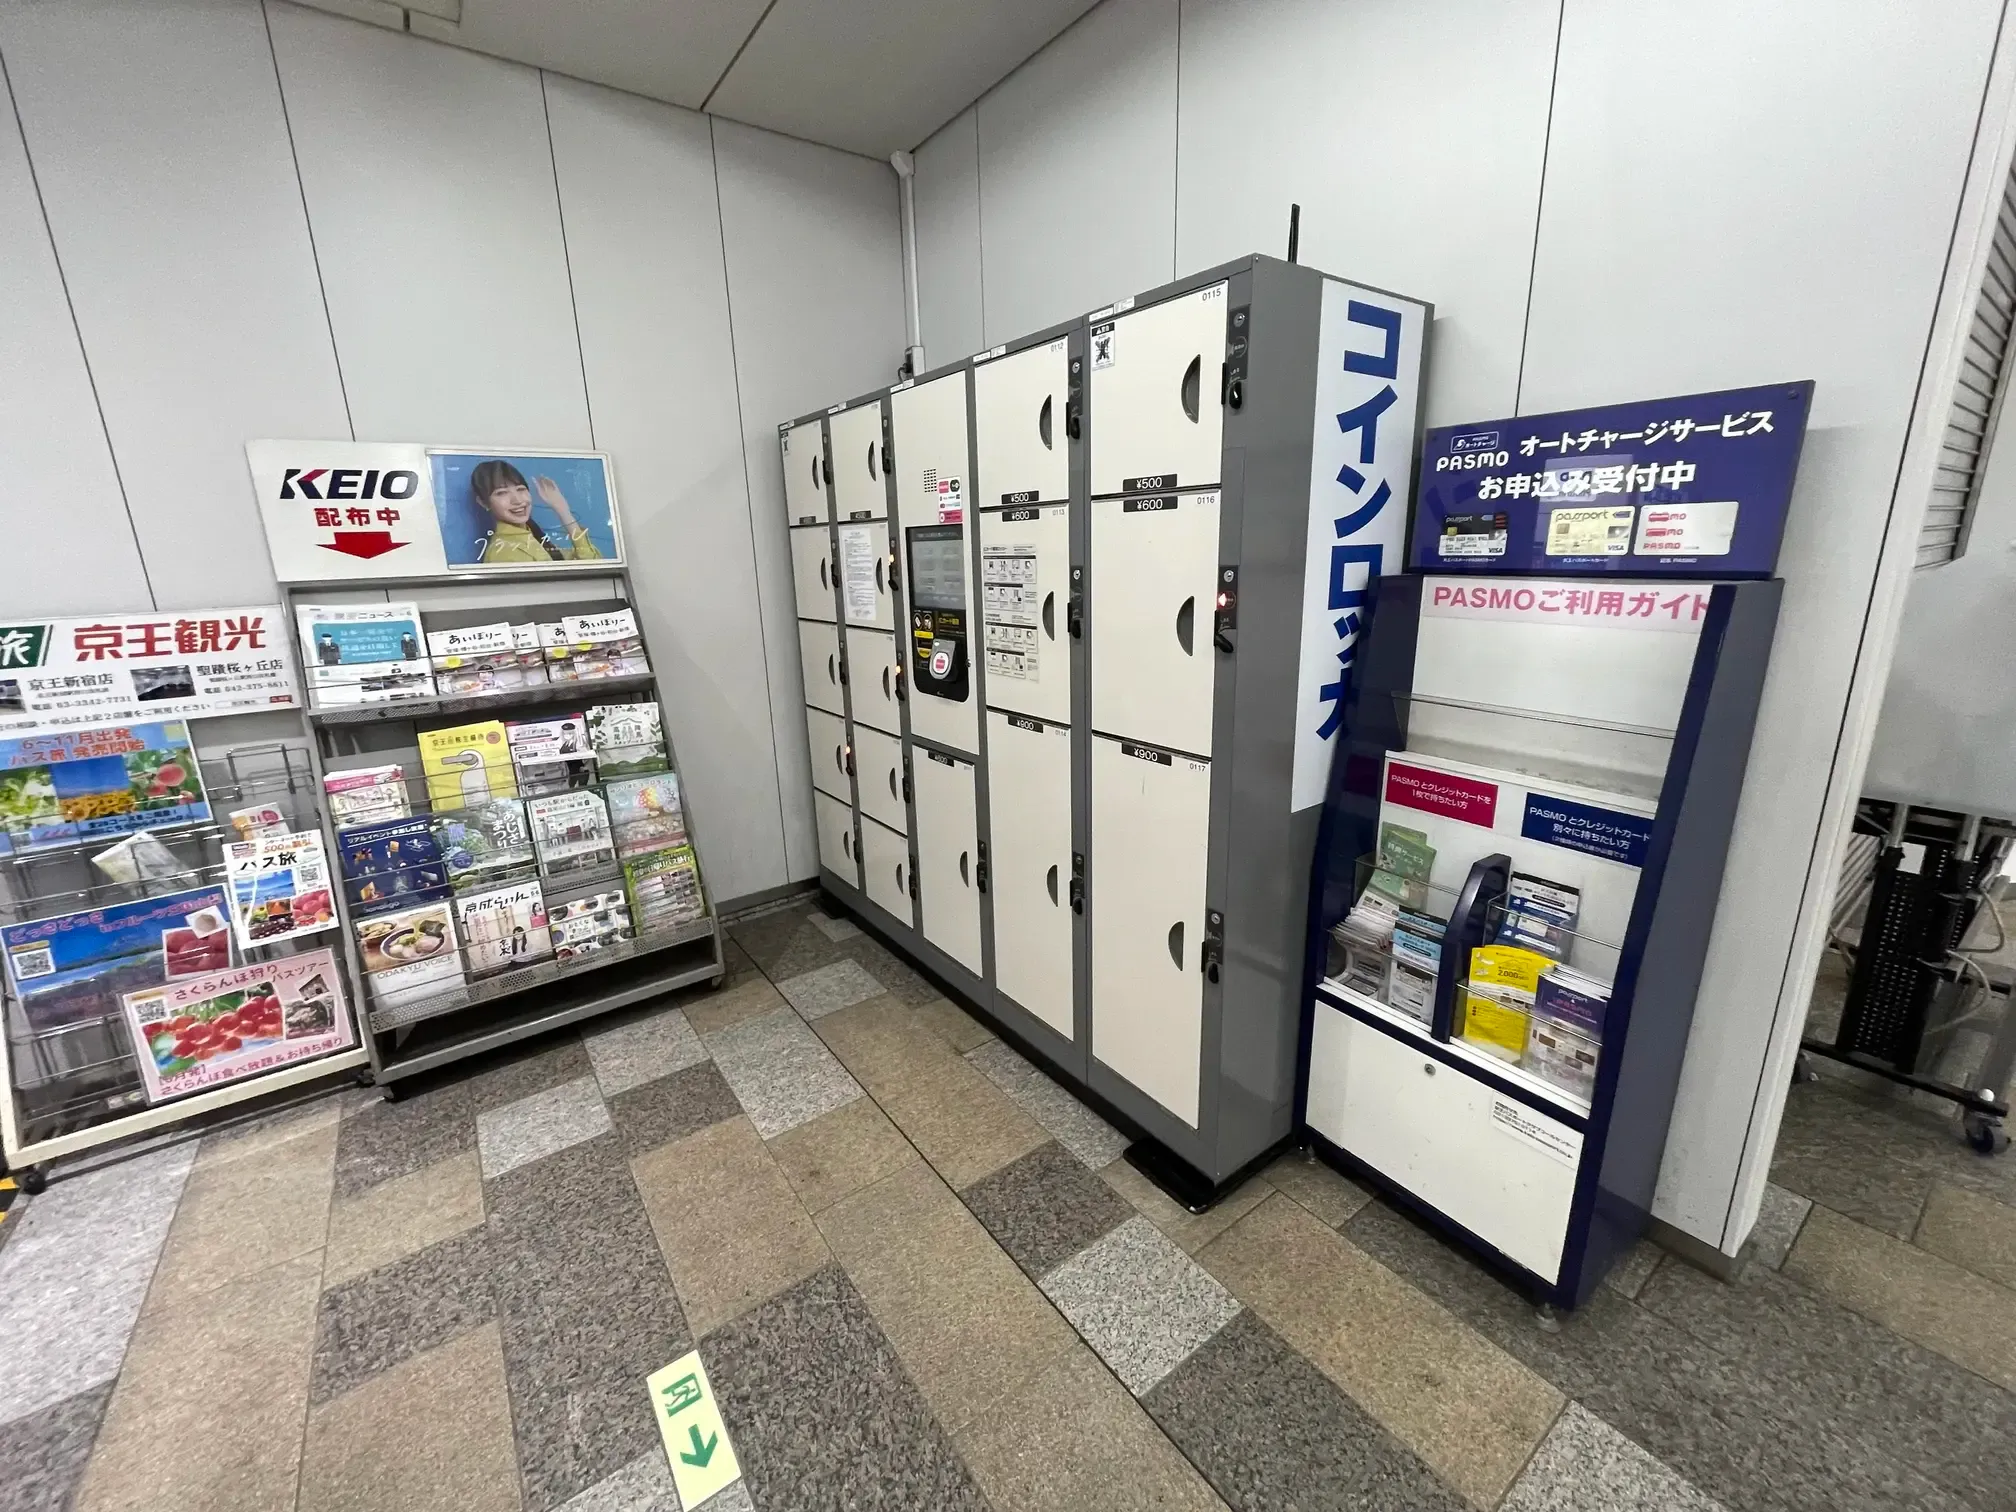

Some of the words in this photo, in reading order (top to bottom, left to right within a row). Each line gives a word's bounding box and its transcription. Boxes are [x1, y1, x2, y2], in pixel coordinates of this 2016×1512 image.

[1202, 288, 1221, 302] 0115
[1519, 410, 1775, 457] オートチャージサービス
[1436, 450, 1509, 472] PASMO
[279, 468, 420, 500] KEIO
[1136, 476, 1163, 490] ¥500
[1478, 460, 1697, 500] お申込み受付中
[1136, 498, 1163, 511] ¥600
[1196, 495, 1215, 506] 0116
[313, 507, 401, 527] 配布中
[73, 615, 266, 662] 京王観光
[449, 632, 502, 645] あいぼりー
[28, 673, 114, 691] 京王新宿店
[1133, 747, 1158, 762] ¥900
[1189, 762, 1206, 773] 0117
[1391, 774, 1421, 788] PASMO
[1420, 782, 1492, 805] とクレジットカードを
[1412, 789, 1469, 810] 1枚で持ちたい方
[1529, 806, 1567, 822] PASMO
[1552, 823, 1631, 850] 別々に持ちたい方
[377, 964, 422, 980] ODAKYU
